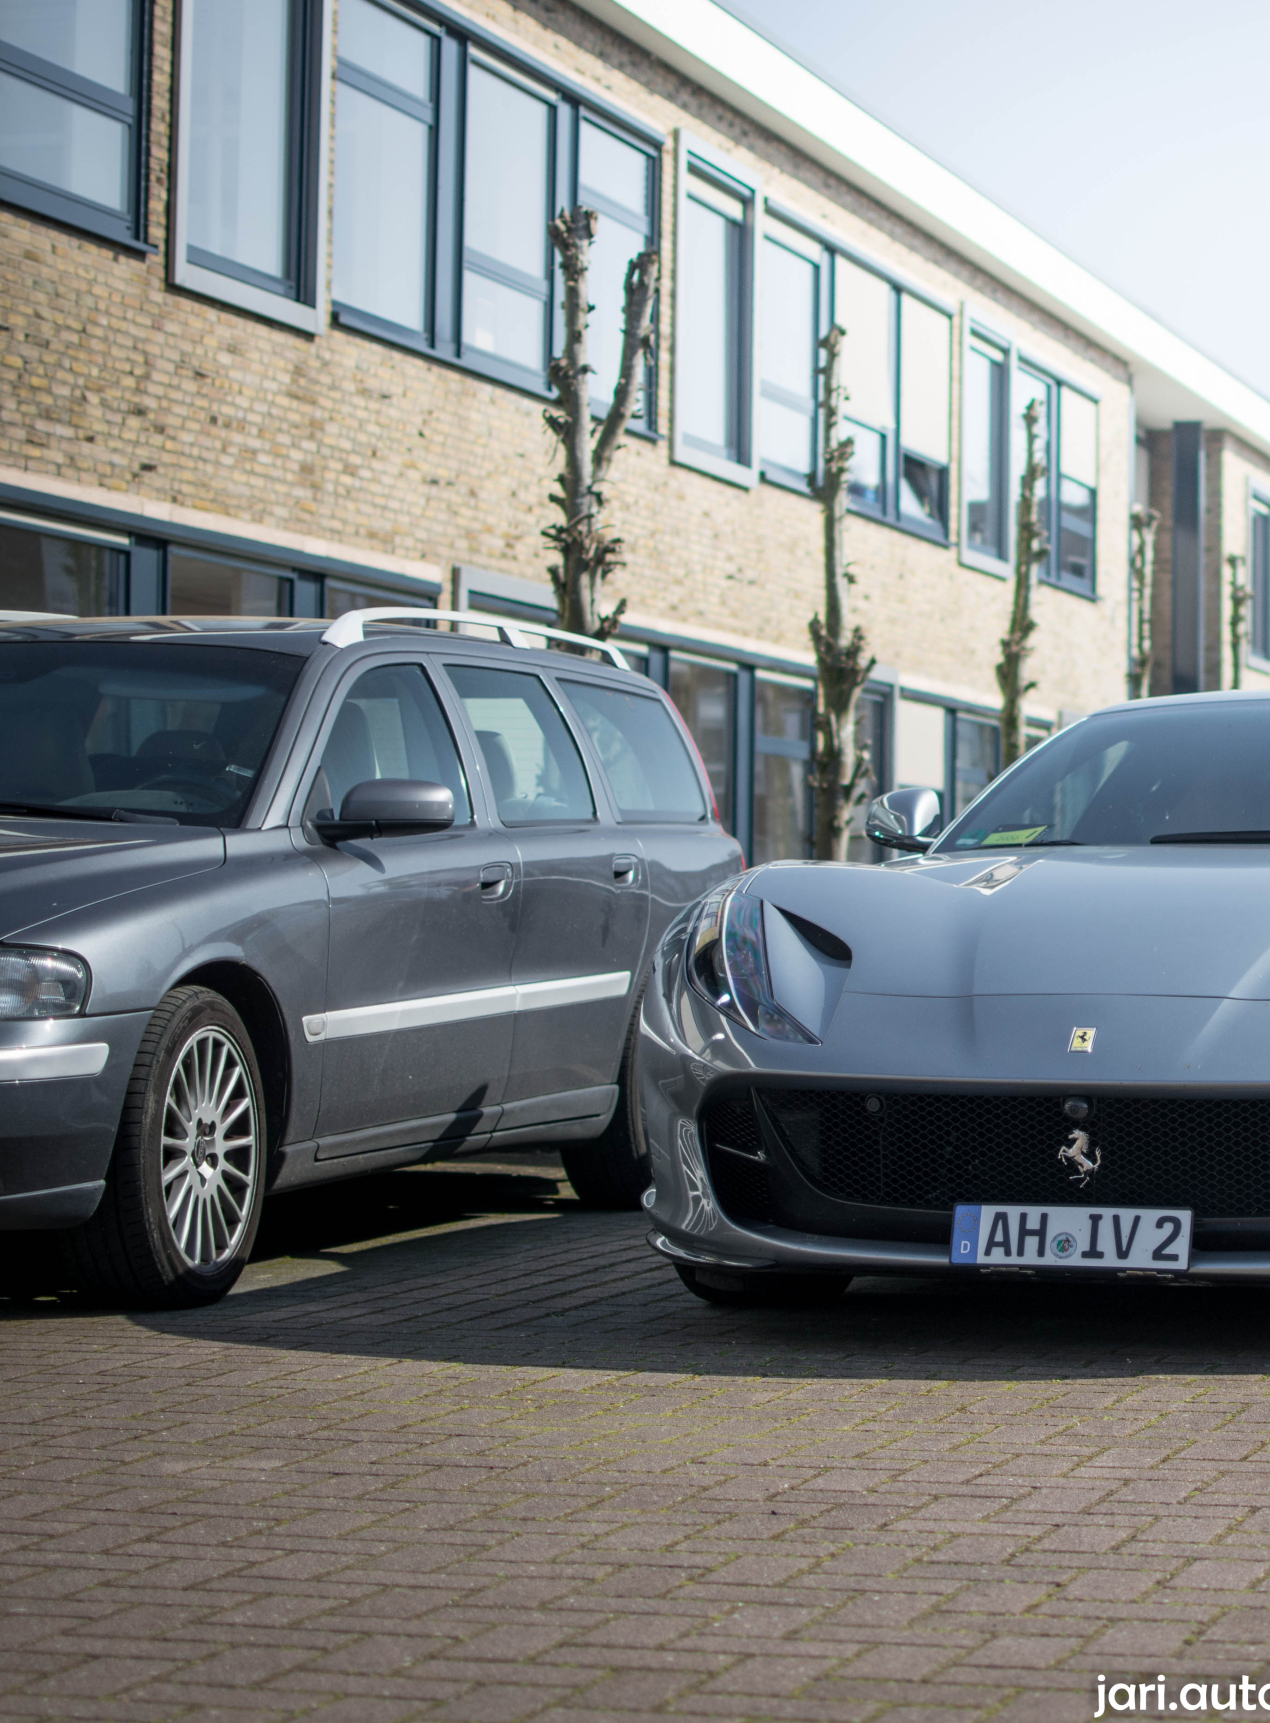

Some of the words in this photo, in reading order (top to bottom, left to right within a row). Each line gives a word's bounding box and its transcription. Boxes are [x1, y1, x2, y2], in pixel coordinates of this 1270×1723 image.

[960, 1241, 971, 1254] D
[983, 1211, 1049, 1258] AH
[1081, 1213, 1142, 1260] IV
[1151, 1215, 1183, 1262] 2
